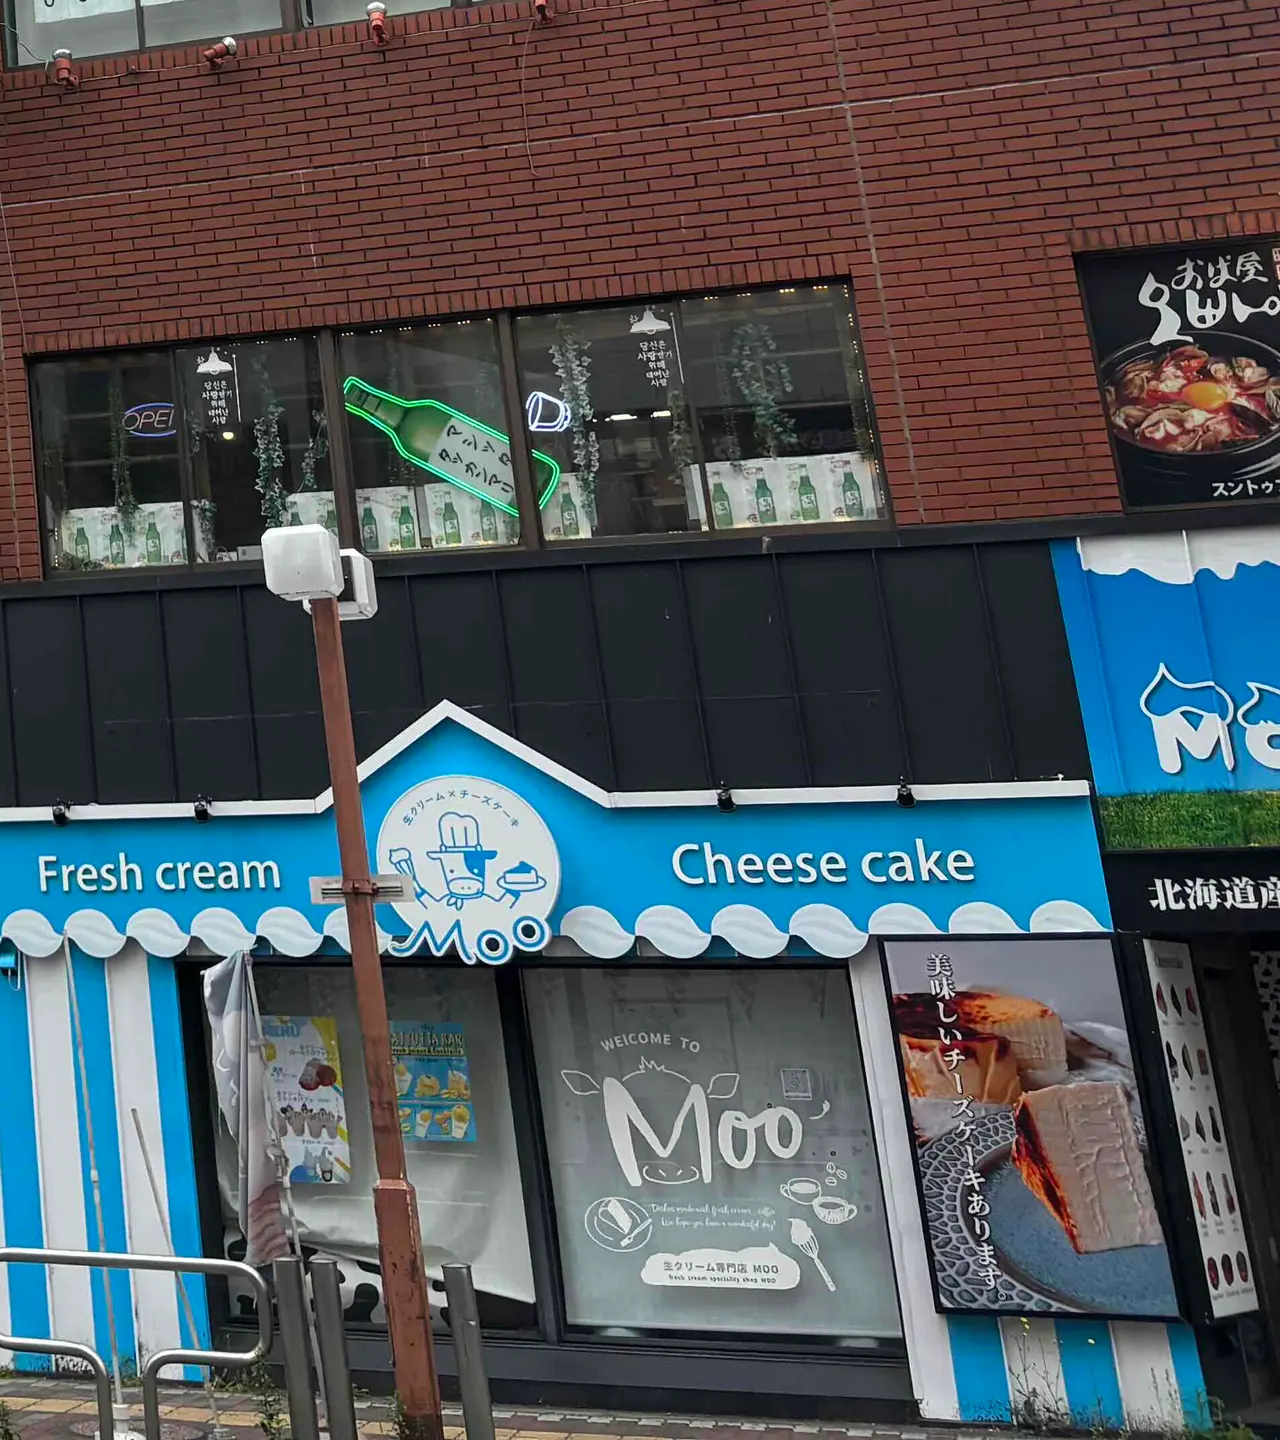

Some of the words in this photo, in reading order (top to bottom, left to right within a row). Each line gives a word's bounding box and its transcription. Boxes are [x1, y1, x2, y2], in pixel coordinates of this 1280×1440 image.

[640, 340, 666, 351] 당신은
[204, 380, 228, 390] 당신은
[38, 853, 143, 892] Fresh
[156, 860, 281, 890] cream
[672, 843, 847, 884] Cheese
[861, 838, 975, 882] cake
[601, 1032, 672, 1053] WELCOME
[679, 1037, 700, 1053] TO
[602, 1076, 803, 1187] Moo
[926, 952, 1007, 1301] 美味しいチーズケーキあります。
[663, 1261, 748, 1274] 生クリーム専門店
[753, 1264, 779, 1274] MOO
